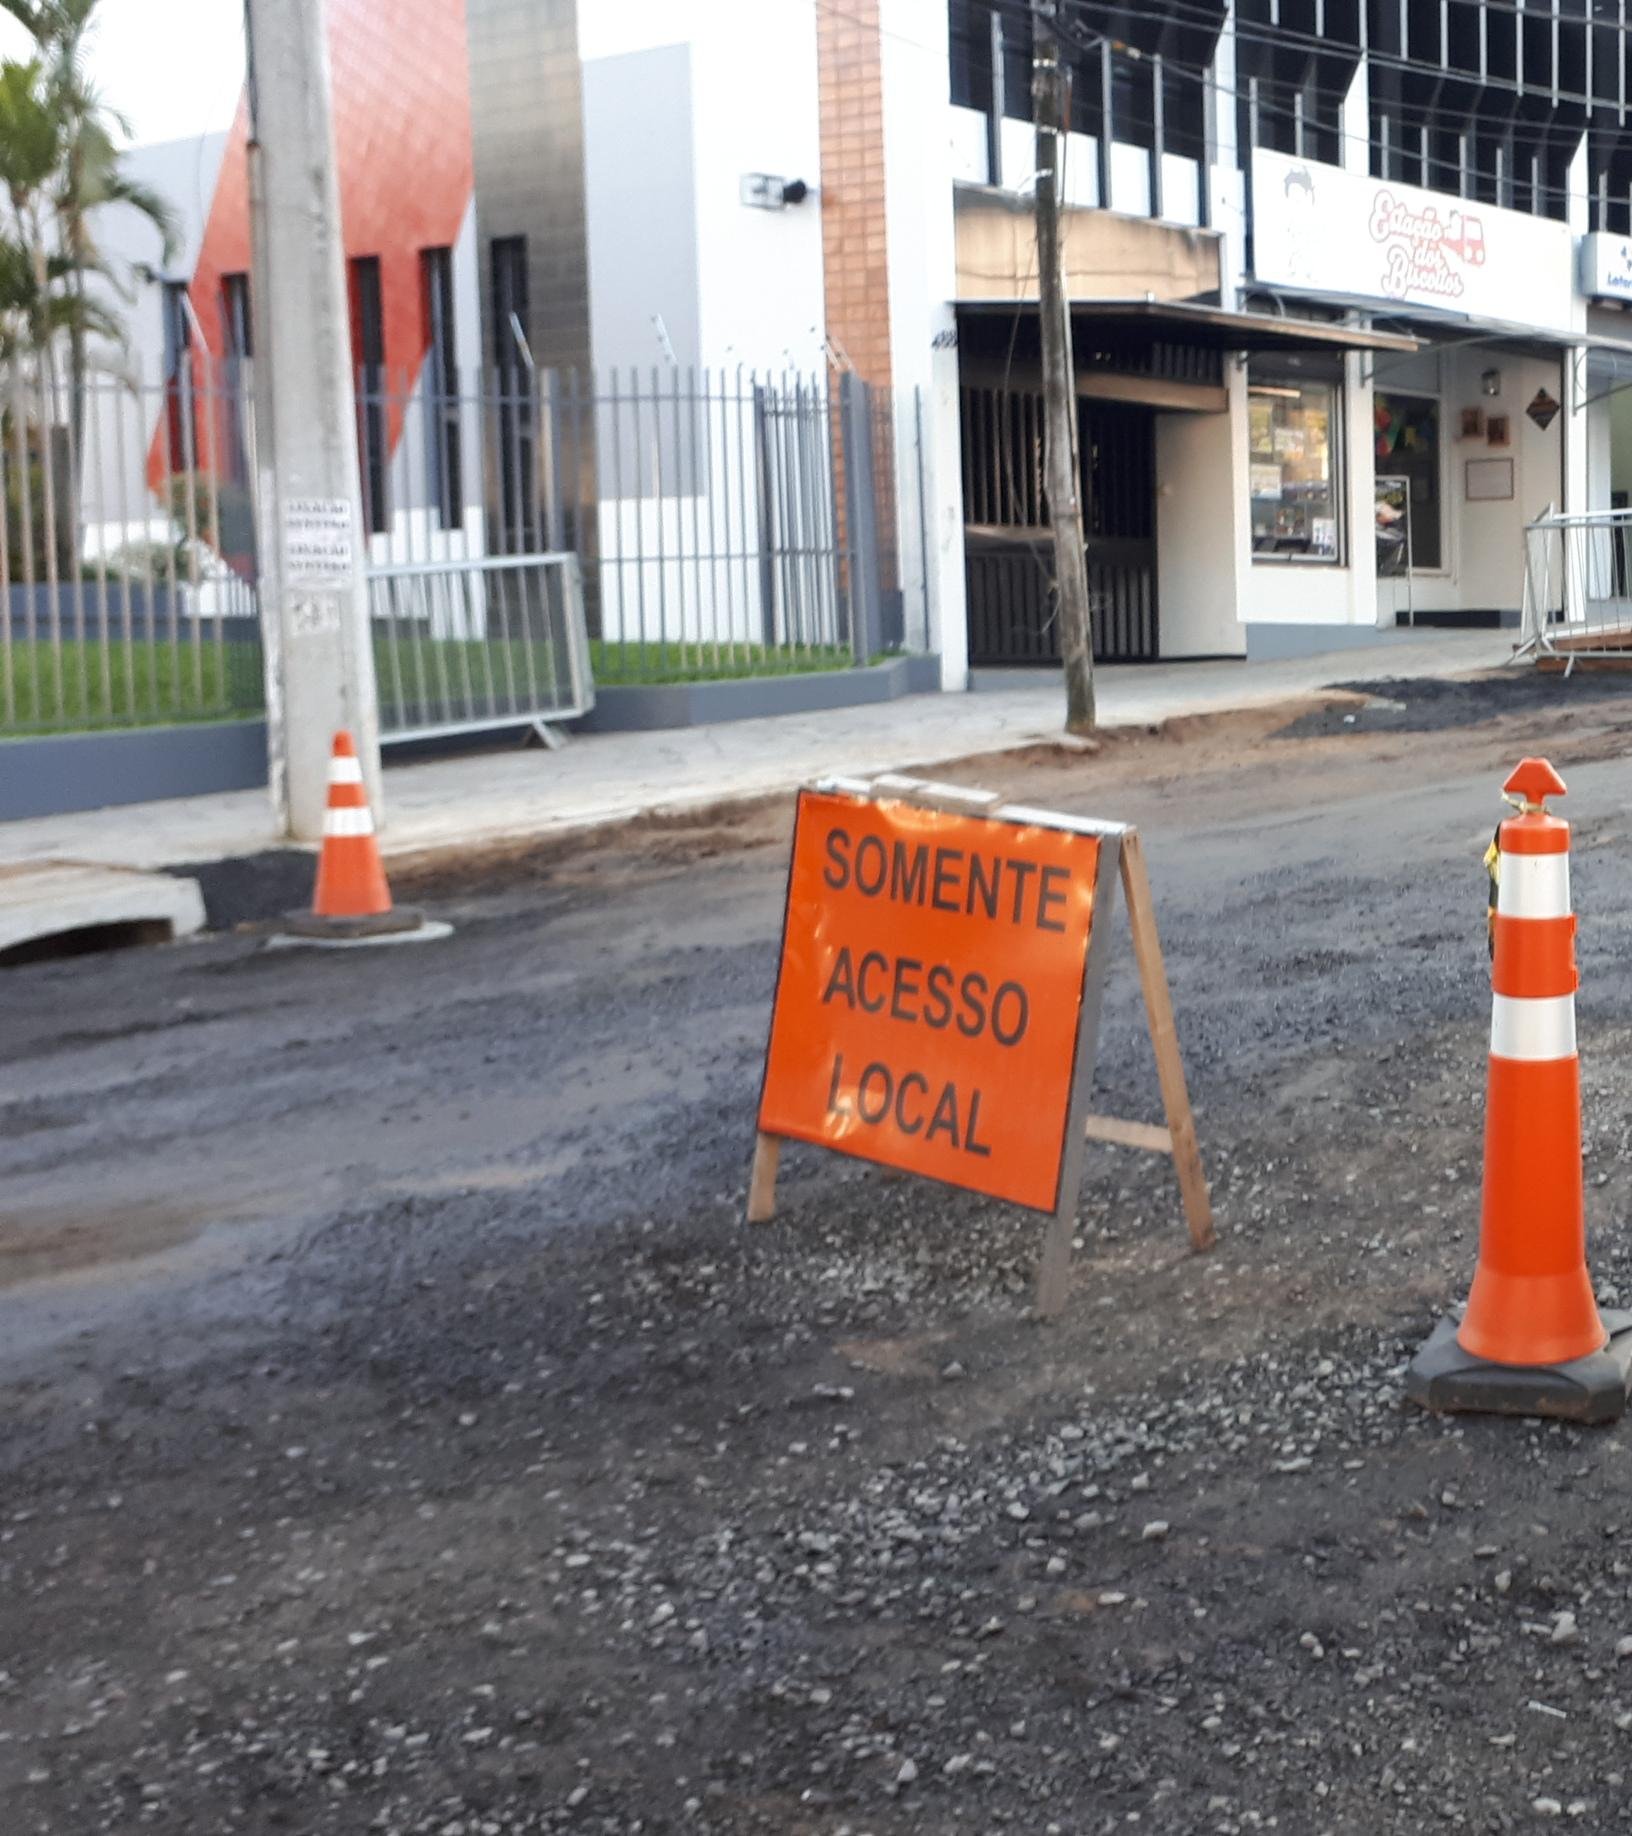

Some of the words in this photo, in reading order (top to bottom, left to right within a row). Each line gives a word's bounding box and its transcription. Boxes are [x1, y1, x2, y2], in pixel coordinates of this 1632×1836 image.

[823, 828, 1072, 933] SOMENTE
[822, 946, 1030, 1047] ACESSO
[827, 1053, 991, 1157] LOCAL
